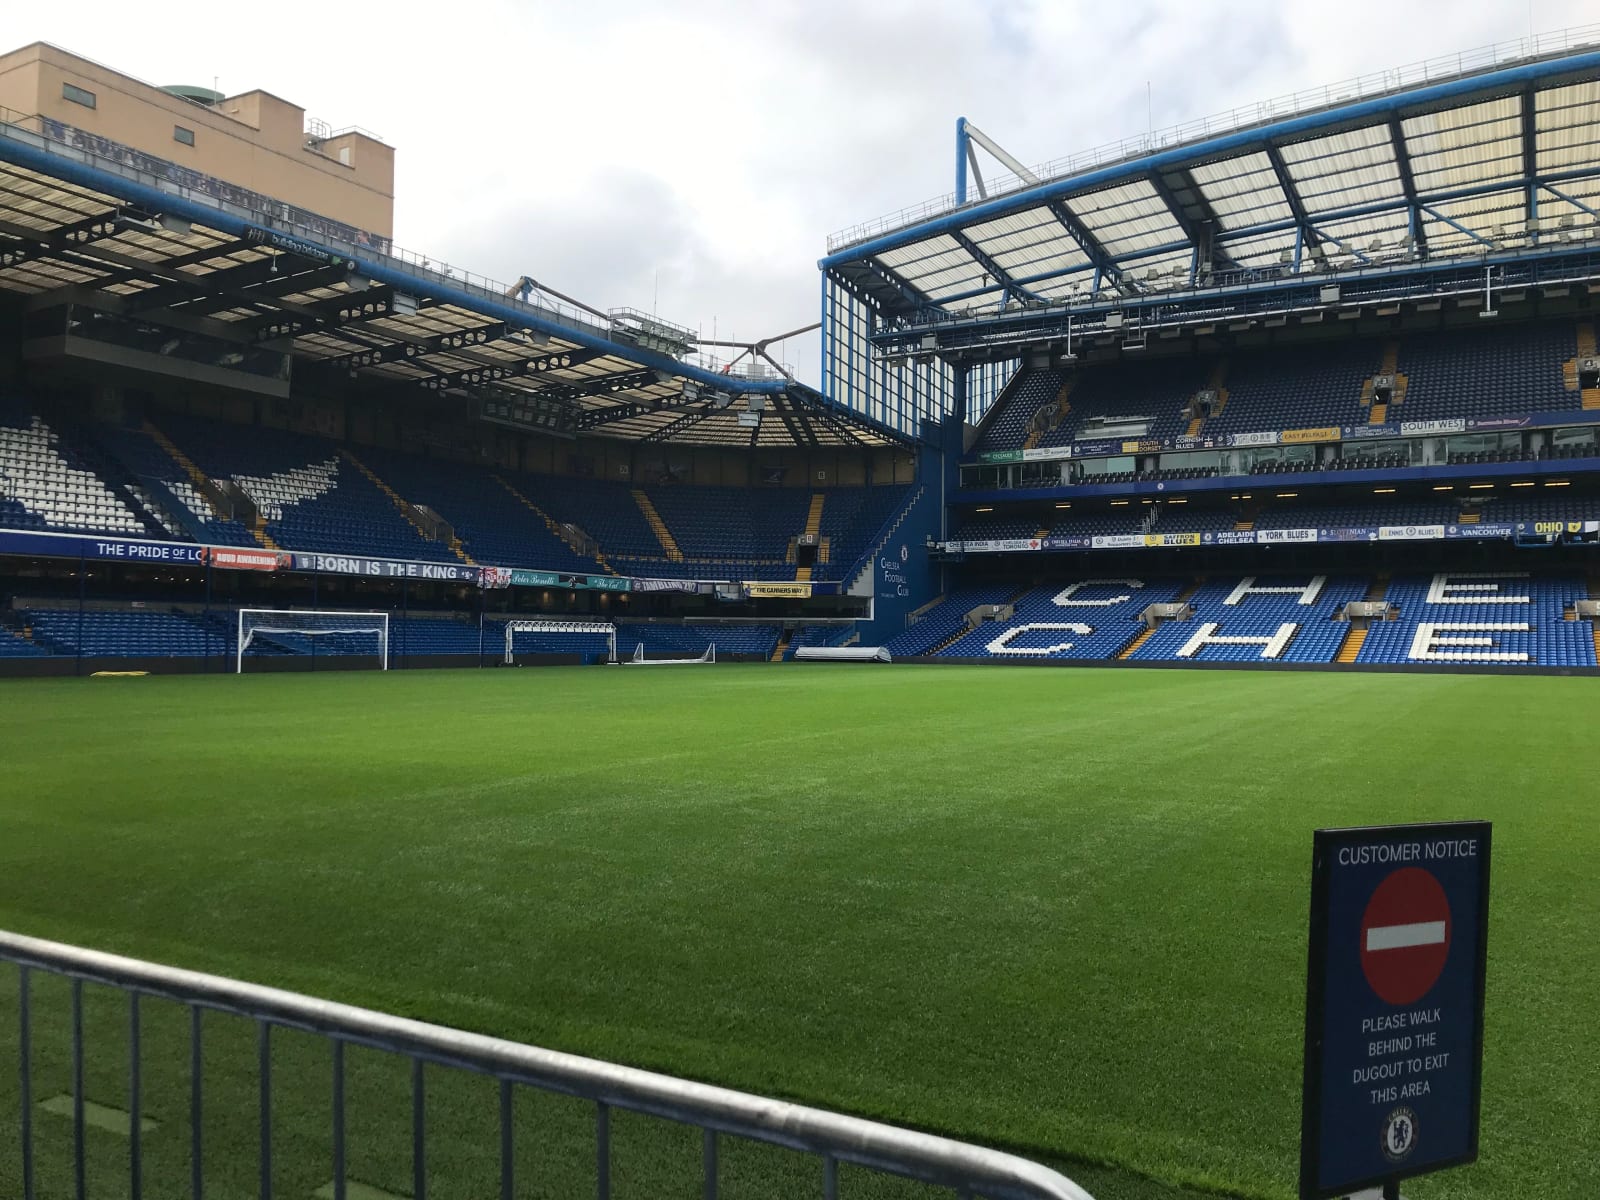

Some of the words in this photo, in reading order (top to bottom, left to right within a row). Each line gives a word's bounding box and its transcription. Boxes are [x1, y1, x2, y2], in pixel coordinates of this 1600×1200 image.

[1402, 421, 1435, 430] SOUTH
[1438, 419, 1464, 428] WEST
[1535, 521, 1564, 533] OHIO
[1217, 531, 1256, 539] ADELAIDE
[1219, 537, 1255, 545] CHELSEA
[1265, 531, 1284, 540] YORK
[1287, 530, 1309, 539] BLUES
[97, 543, 126, 556] THE
[129, 545, 170, 559] PRIDE
[172, 550, 186, 560] OF
[314, 556, 360, 575] BORN
[366, 561, 381, 576] IS
[387, 563, 417, 577] THE
[422, 565, 457, 579] KING
[881, 557, 901, 571] CHELSEA
[885, 570, 907, 584] FOOTBALL
[642, 581, 683, 592] TAMBLING
[683, 581, 697, 593] 202
[1338, 842, 1421, 866] CUSTOMER
[1424, 838, 1478, 860] NOTICE
[1362, 1013, 1407, 1033] PLEASE
[1410, 1007, 1442, 1026] WALK
[1368, 1036, 1412, 1057] BEHIND
[1415, 1032, 1437, 1048] THE
[1352, 1061, 1404, 1084] DUGOUT
[1407, 1057, 1422, 1075] TO
[1425, 1052, 1450, 1071] EXIT
[1370, 1088, 1398, 1104] THIS
[1400, 1079, 1431, 1099] AREA
